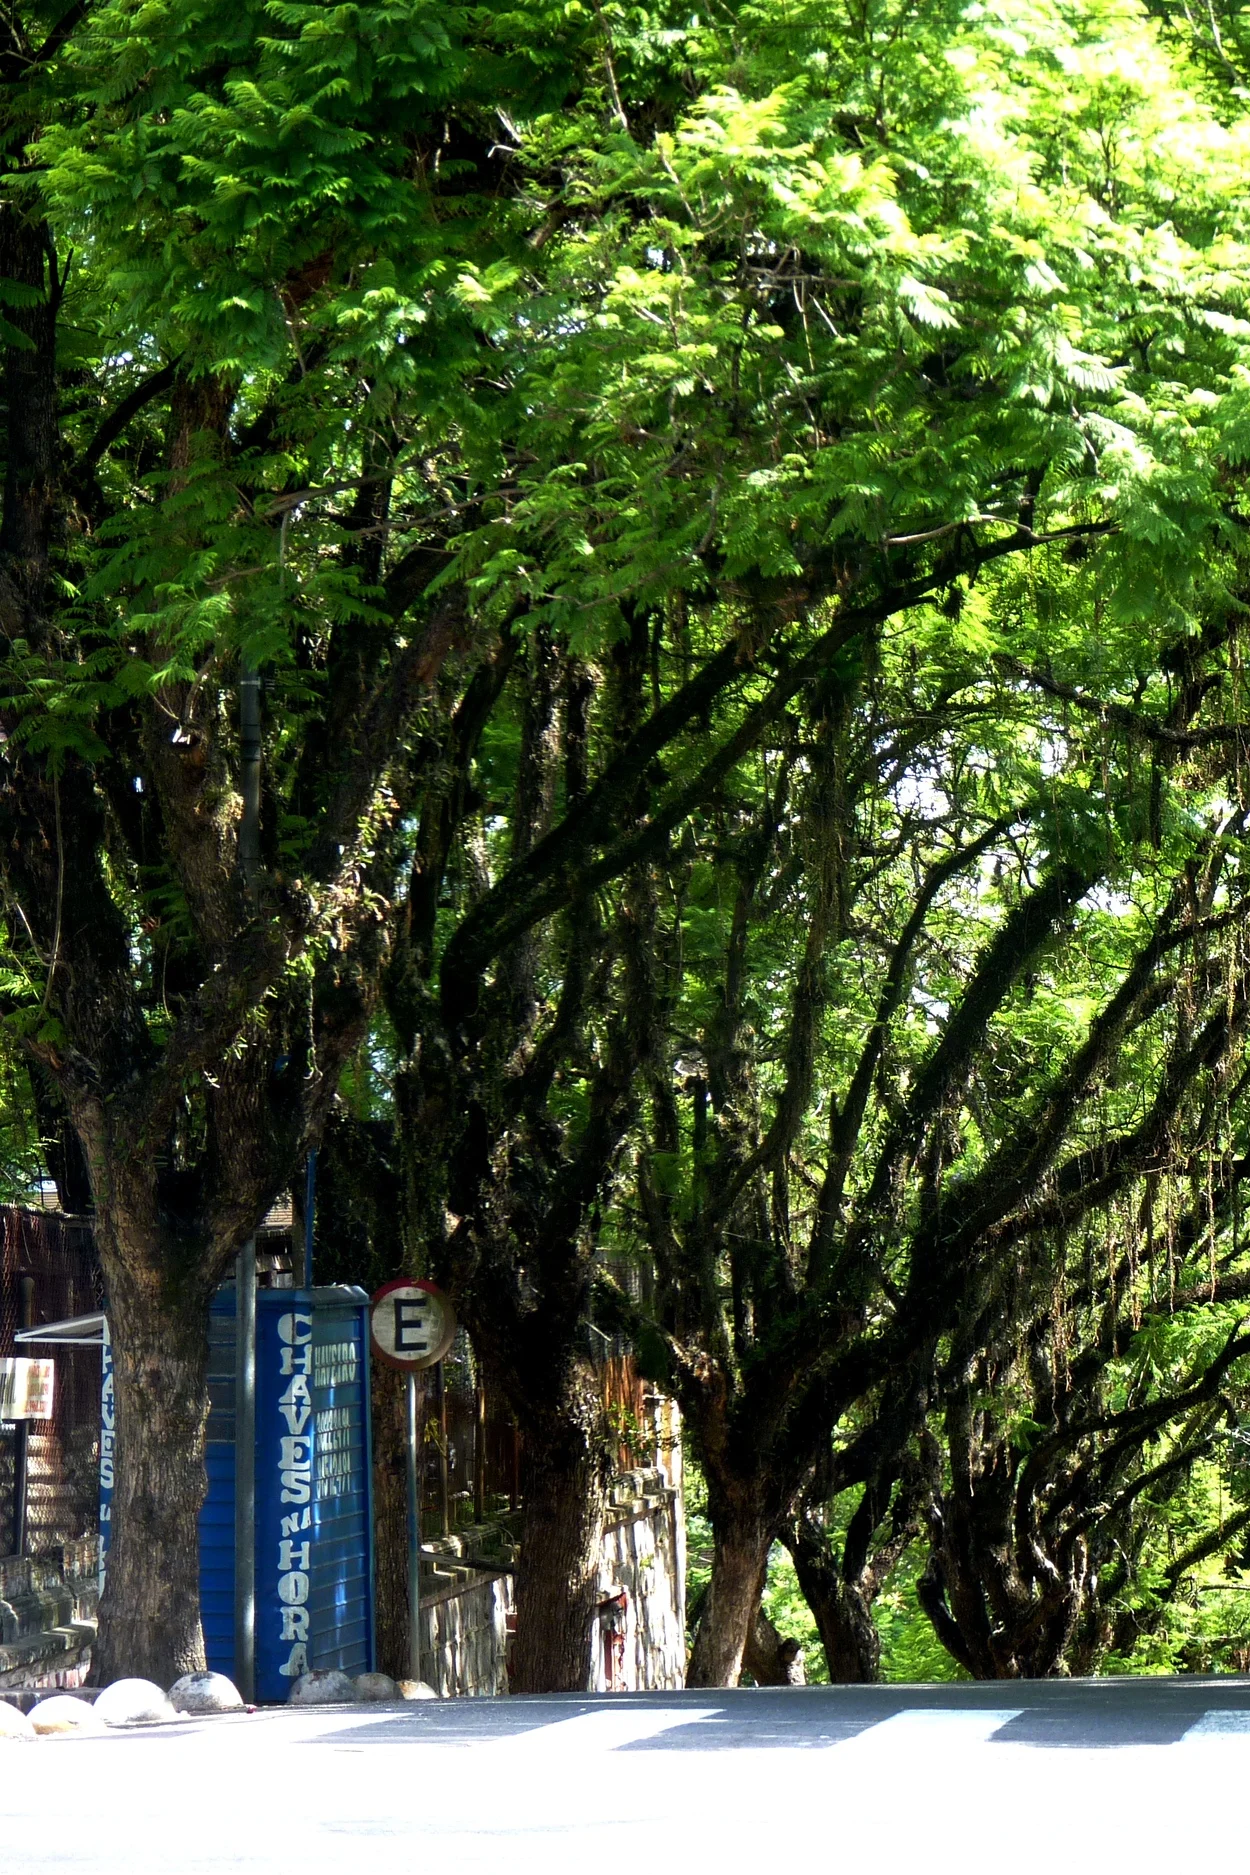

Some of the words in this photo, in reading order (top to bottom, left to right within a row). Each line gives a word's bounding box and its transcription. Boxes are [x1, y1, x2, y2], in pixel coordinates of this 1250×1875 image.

[394, 1299, 427, 1352] E
[314, 1342, 356, 1387] HAVEIRO
[278, 1312, 312, 1504] CHAVES
[280, 1505, 311, 1537] NA
[277, 1539, 310, 1677] HORA
